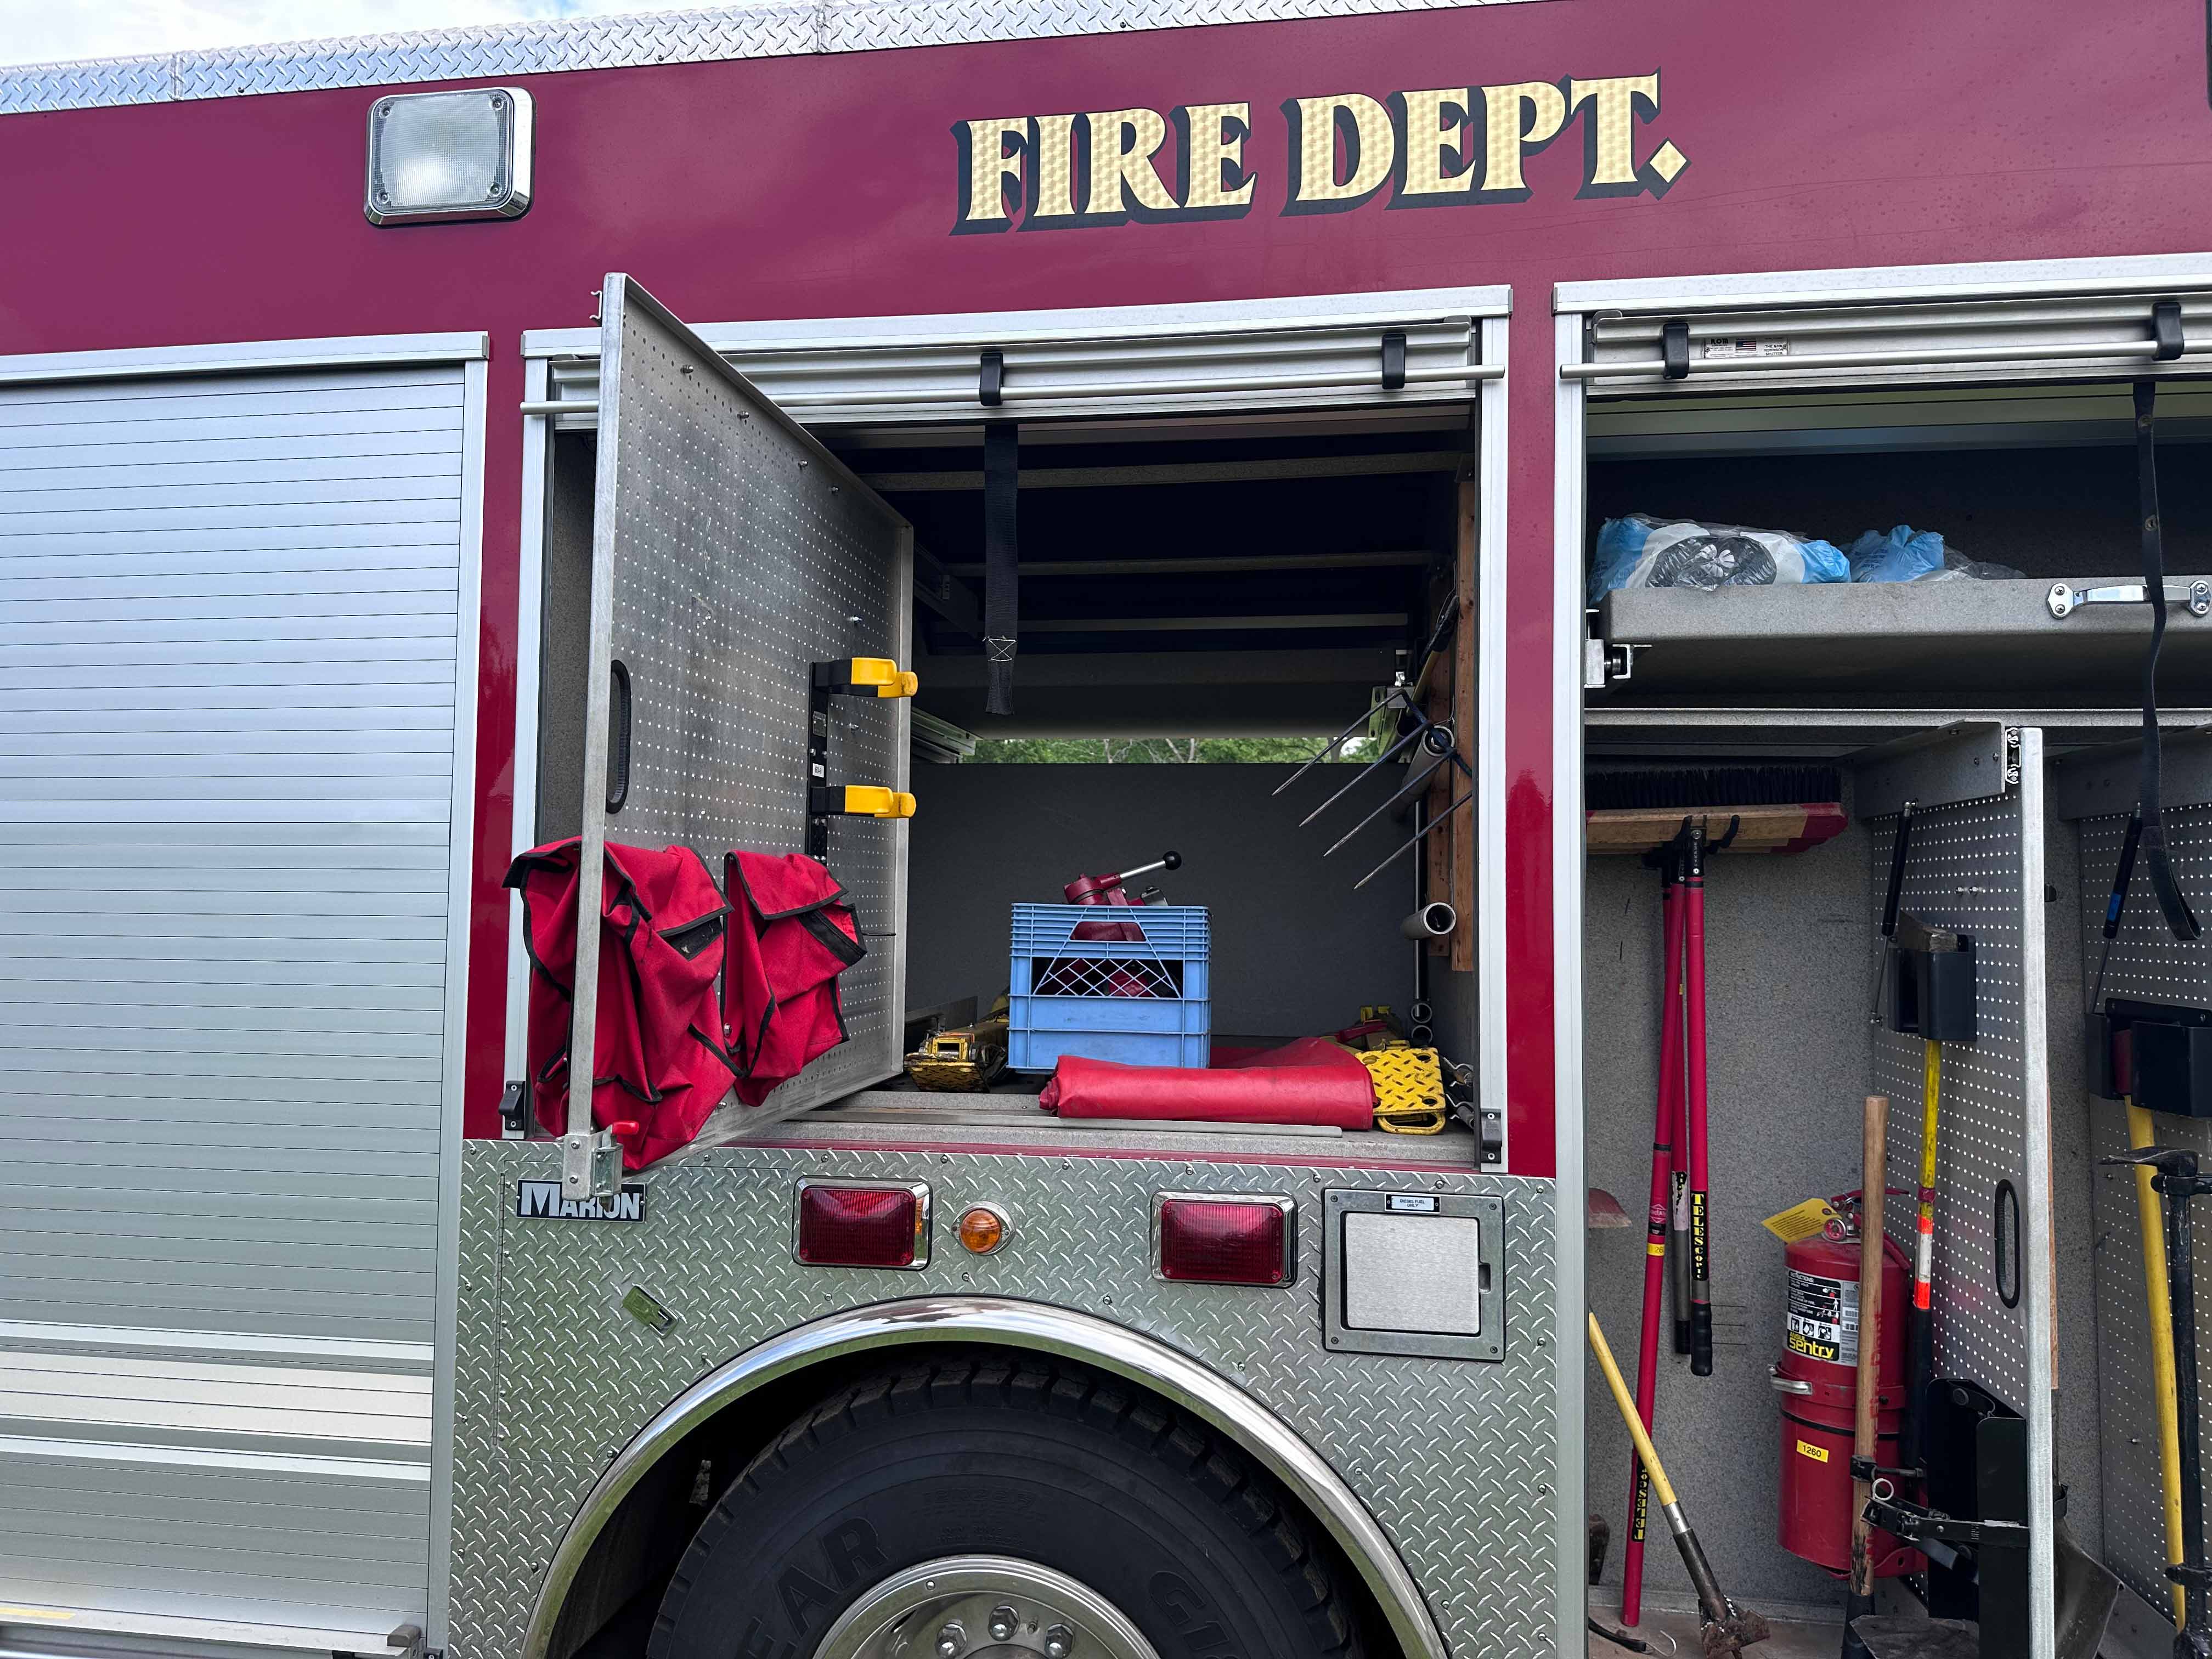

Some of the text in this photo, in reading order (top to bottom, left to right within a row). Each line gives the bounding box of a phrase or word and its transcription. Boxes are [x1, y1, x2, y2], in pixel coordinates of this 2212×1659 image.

[950, 67, 1688, 236] FIRE DEPT.
[1803, 1445, 1821, 1457] 1260
[1149, 1571, 1238, 1659] G1
